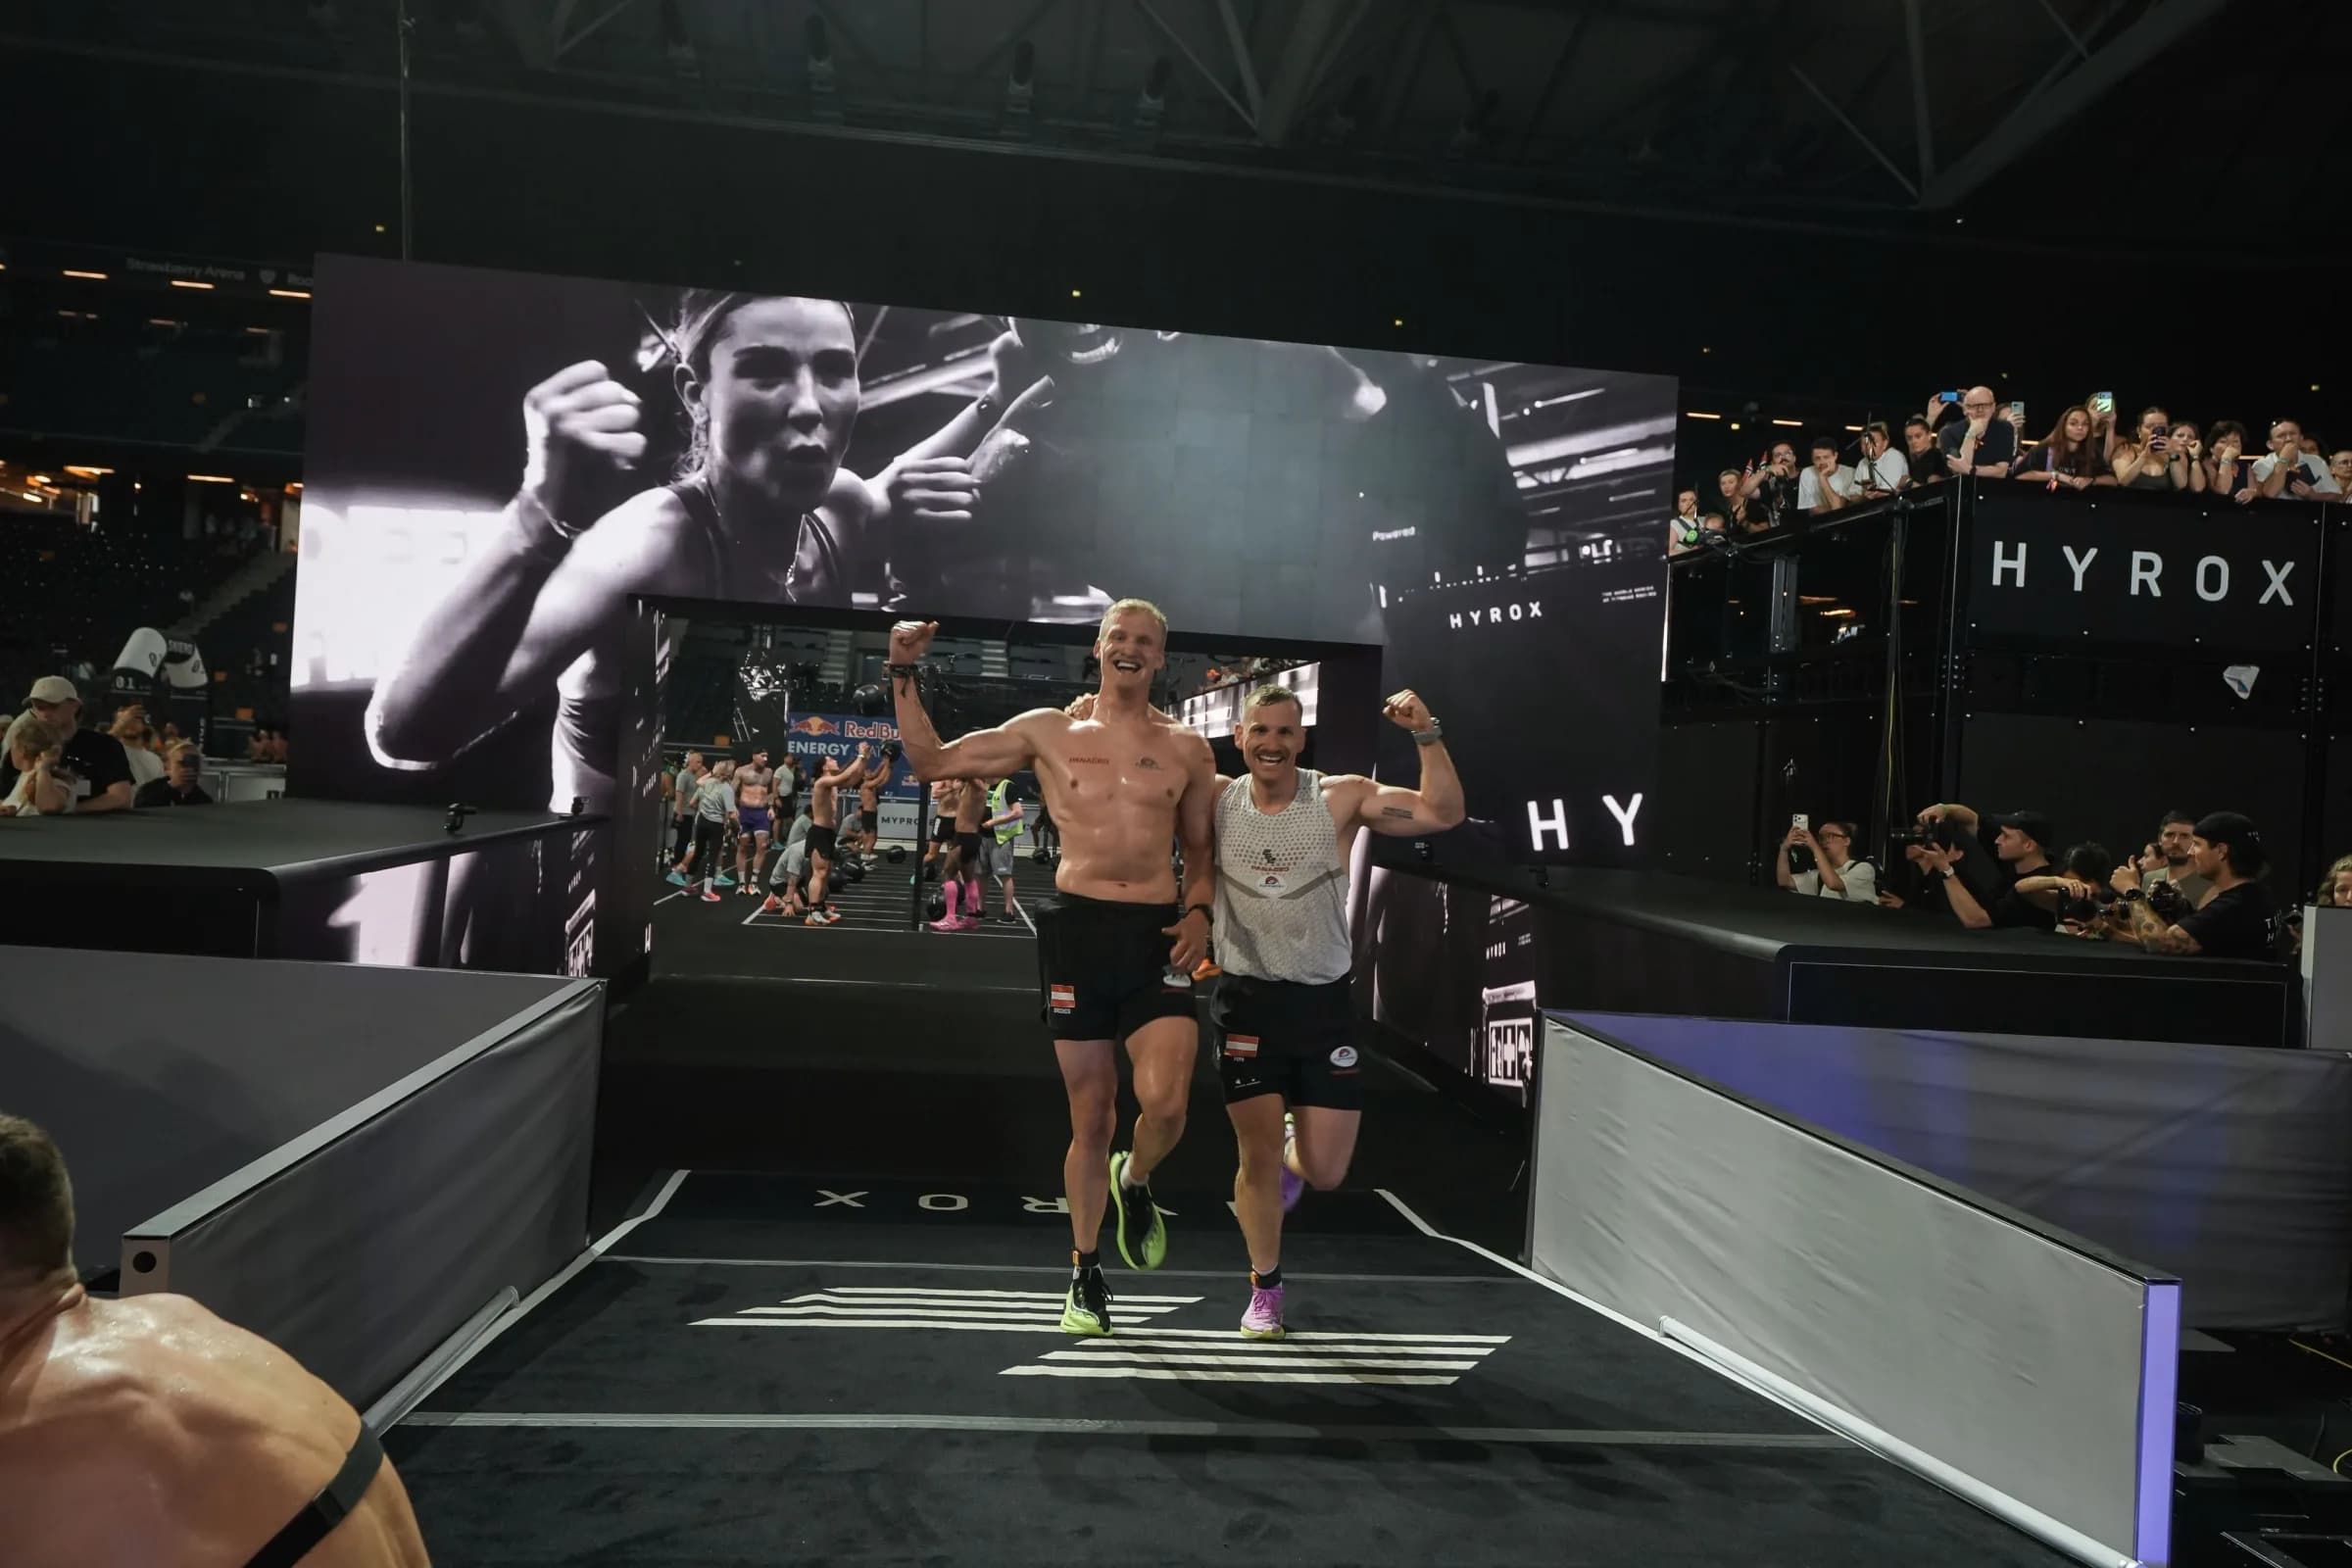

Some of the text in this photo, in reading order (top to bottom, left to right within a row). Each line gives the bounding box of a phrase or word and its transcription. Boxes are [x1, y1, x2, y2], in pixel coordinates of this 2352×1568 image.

[204, 264, 245, 280] Arena
[1372, 526, 1415, 541] Powered
[1991, 540, 2295, 607] HYROX
[1449, 601, 1543, 628] HYROX
[787, 740, 851, 757] ENERGY
